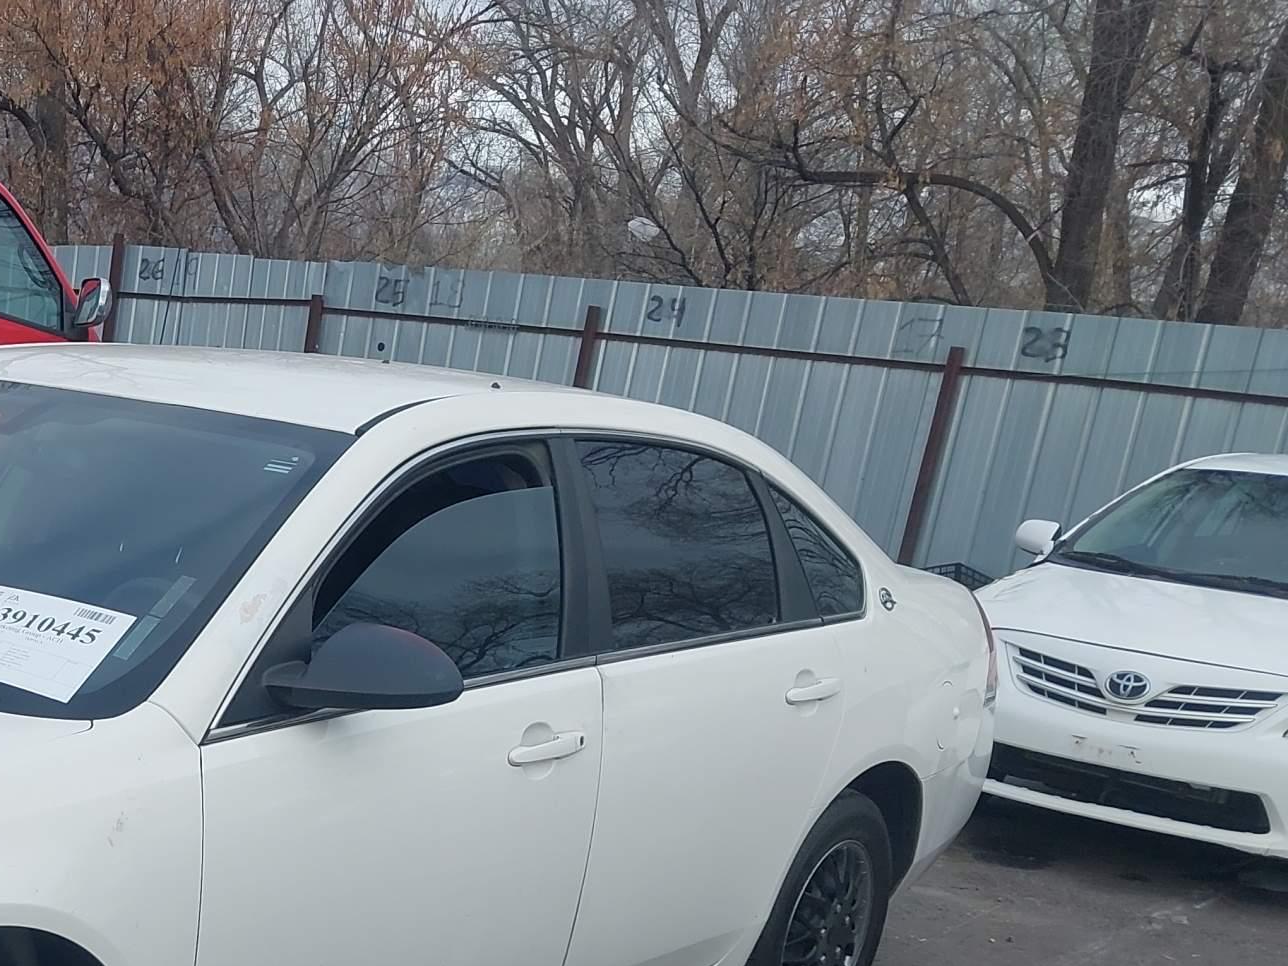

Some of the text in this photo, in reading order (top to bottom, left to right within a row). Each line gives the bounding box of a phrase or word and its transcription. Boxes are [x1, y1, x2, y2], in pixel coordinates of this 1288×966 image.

[138, 258, 166, 281] 26
[375, 276, 410, 307] 25
[647, 295, 687, 328] 24
[1021, 326, 1072, 362] 23
